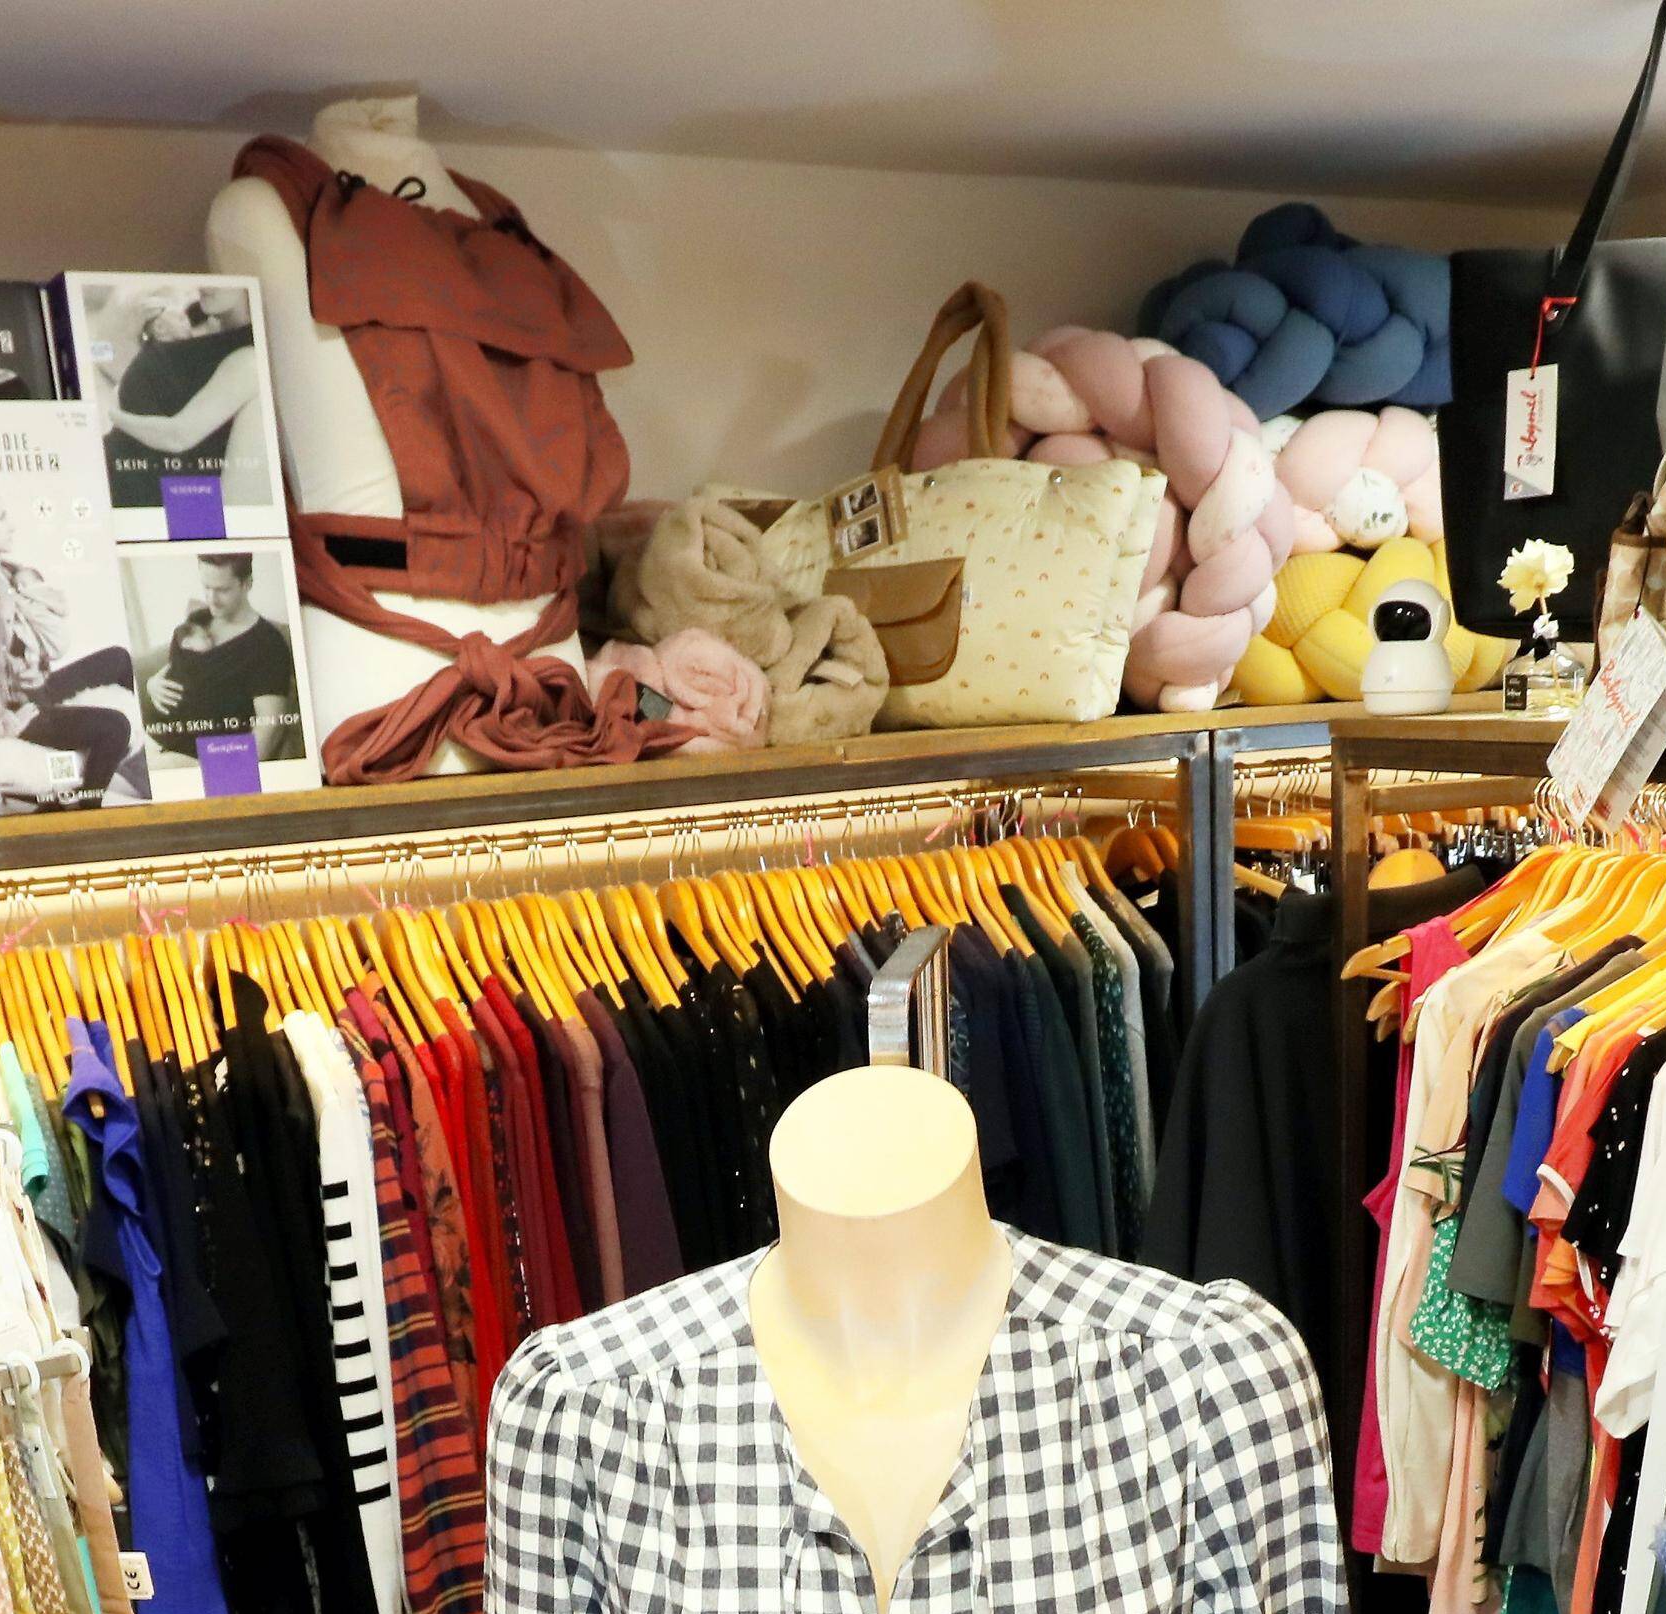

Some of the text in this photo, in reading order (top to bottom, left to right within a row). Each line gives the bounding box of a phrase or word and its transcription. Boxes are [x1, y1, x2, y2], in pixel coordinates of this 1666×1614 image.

[115, 457, 149, 471] SKIN
[164, 458, 182, 471] TO
[146, 719, 183, 735] MEN'S
[186, 718, 213, 733] SKIN
[223, 717, 240, 731] TO
[249, 714, 277, 729] SKIN
[278, 713, 301, 726] TOP
